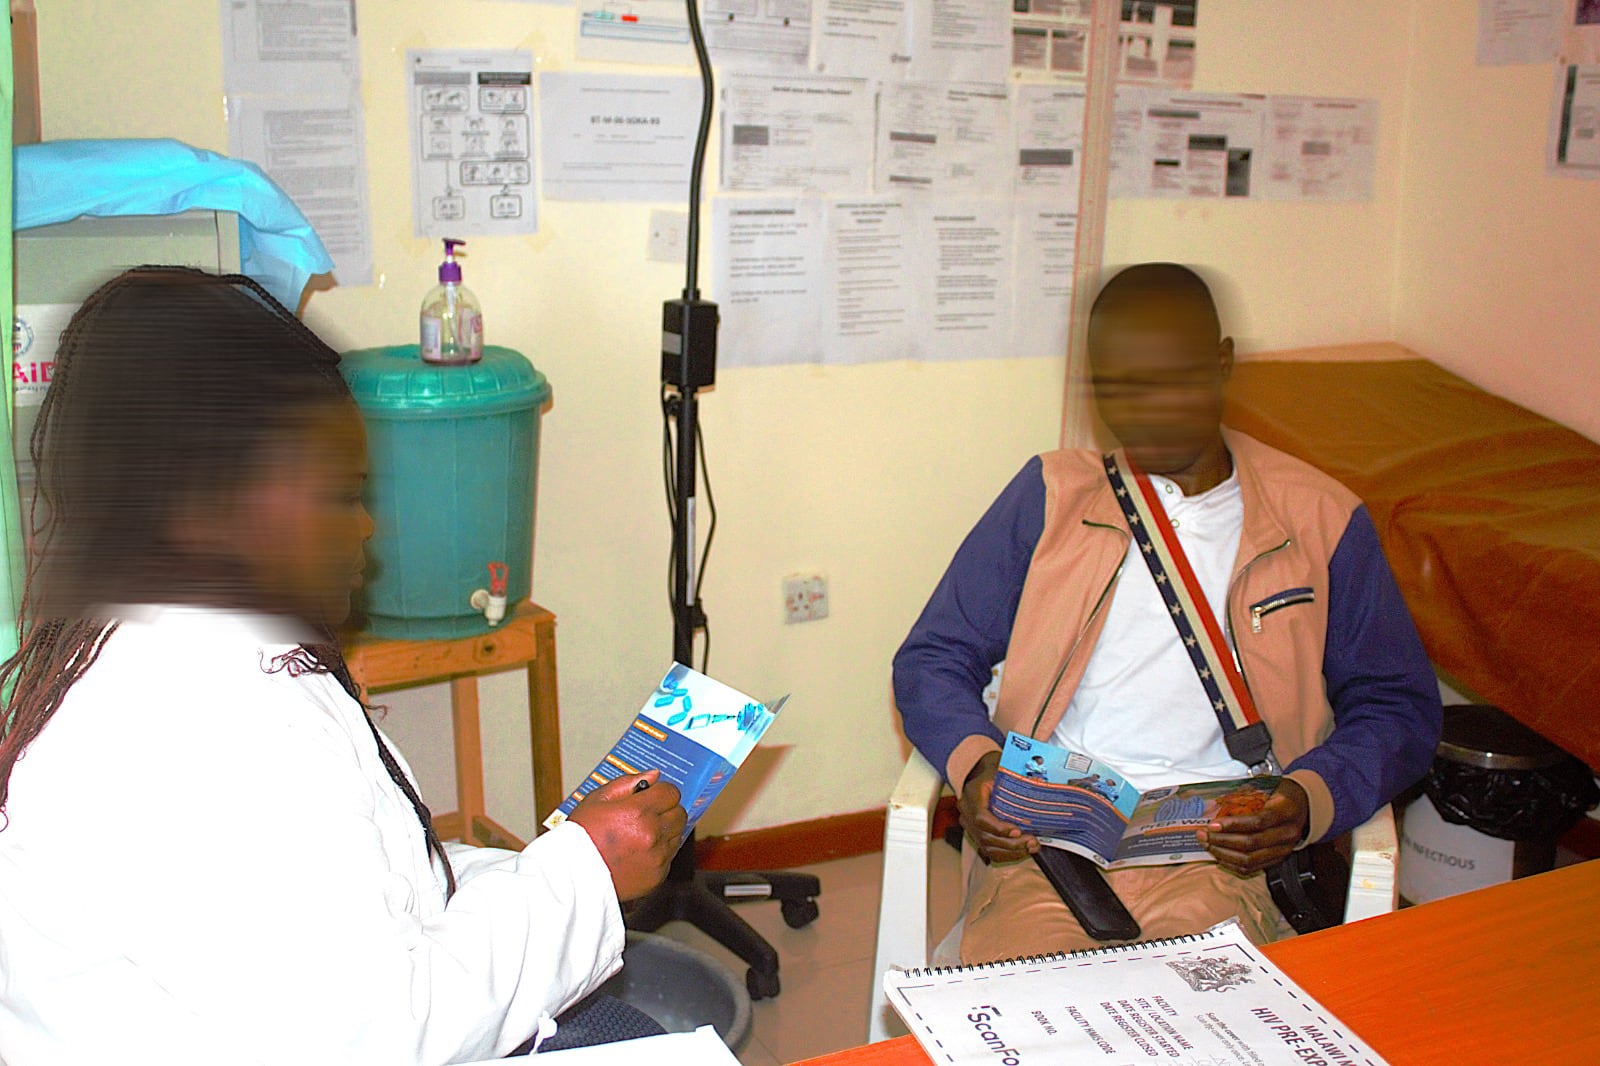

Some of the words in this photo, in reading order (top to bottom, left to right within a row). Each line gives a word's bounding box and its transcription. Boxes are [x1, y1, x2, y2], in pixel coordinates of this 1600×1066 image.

[1152, 995, 1179, 1016] FACILITY
[1250, 1007, 1283, 1025] HIV
[1031, 1010, 1050, 1028] BOOK
[1043, 1024, 1058, 1036] NO.
[1065, 1005, 1090, 1028] FACILITY
[1096, 1040, 1116, 1055] CODE
[1100, 1001, 1118, 1015] DATE
[1112, 1014, 1141, 1039] REGISTER
[1134, 1037, 1159, 1057] CLOSED
[1117, 999, 1135, 1013] DATE
[1130, 1012, 1158, 1039] REGISTER
[1152, 1036, 1180, 1058] STARTED
[1134, 997, 1151, 1009] SITE
[1150, 1012, 1178, 1037] LOCATION
[1173, 1034, 1194, 1050] NAME
[1224, 1029, 1241, 1040] cover
[1300, 1024, 1347, 1058] MALAWI
